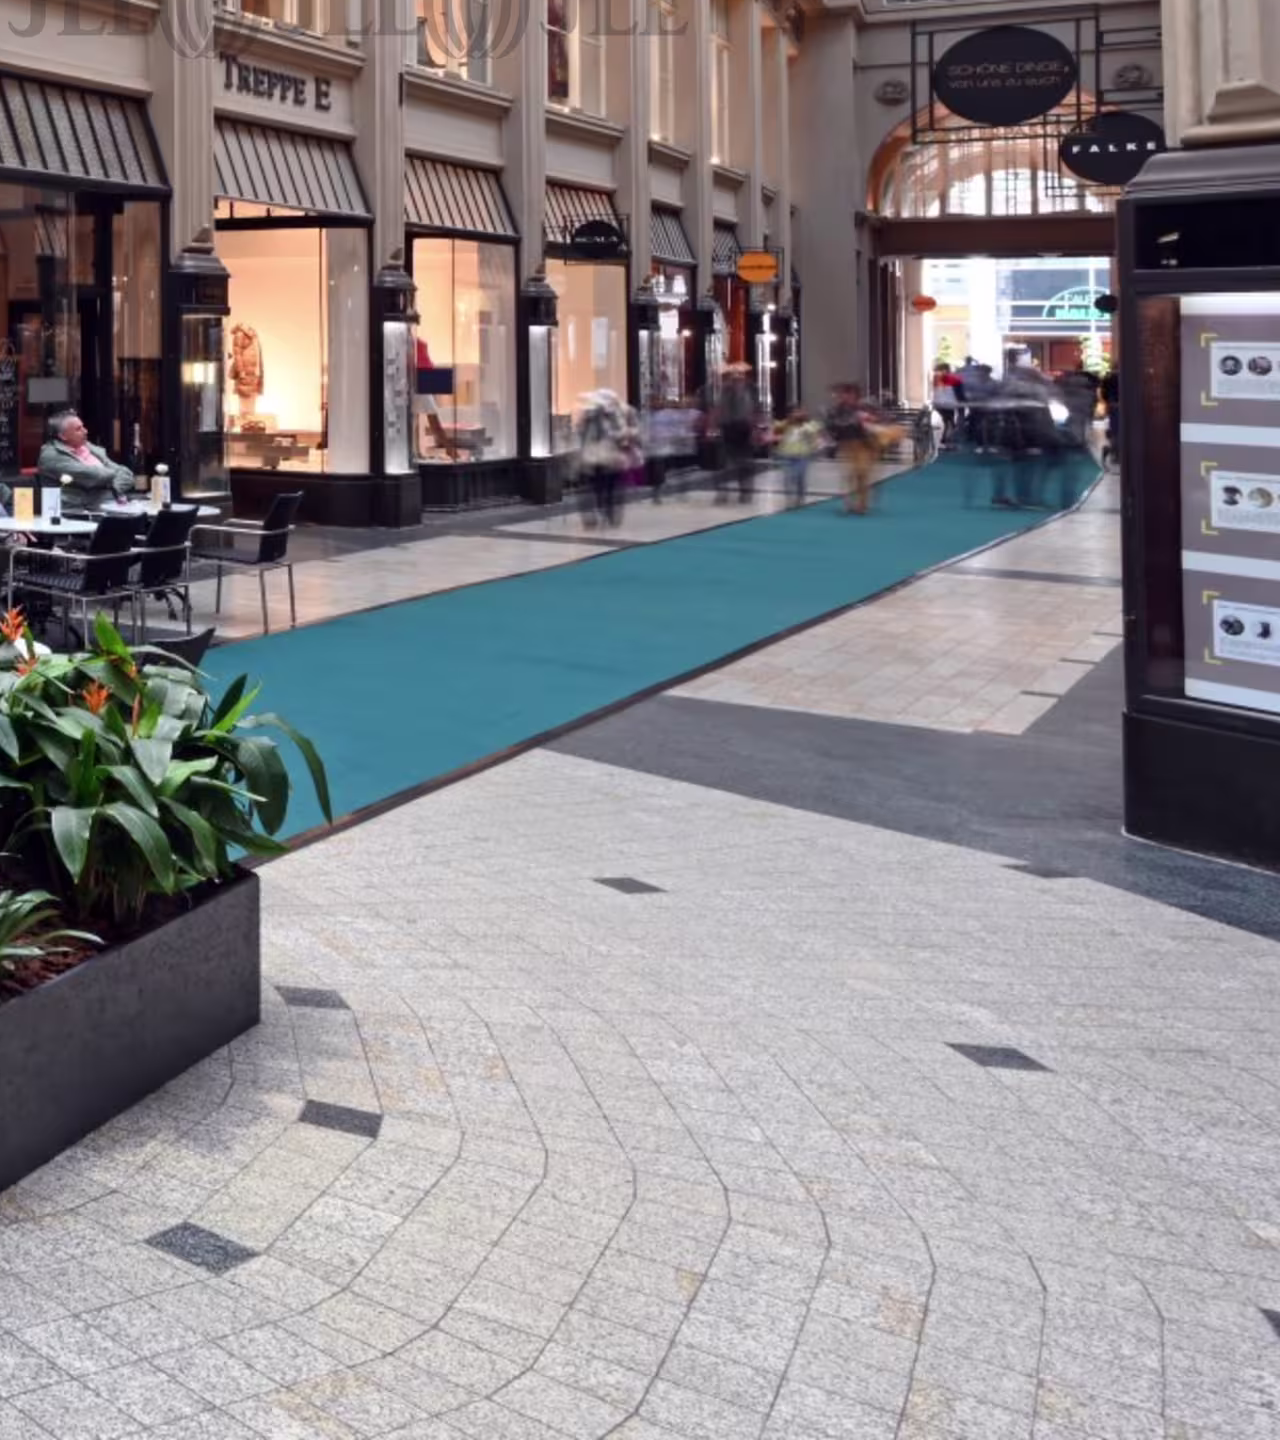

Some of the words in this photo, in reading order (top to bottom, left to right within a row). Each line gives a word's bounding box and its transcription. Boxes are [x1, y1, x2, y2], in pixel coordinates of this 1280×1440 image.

[219, 51, 307, 107] TREPPE
[314, 76, 331, 112] E
[1071, 141, 1157, 154] FALKE
